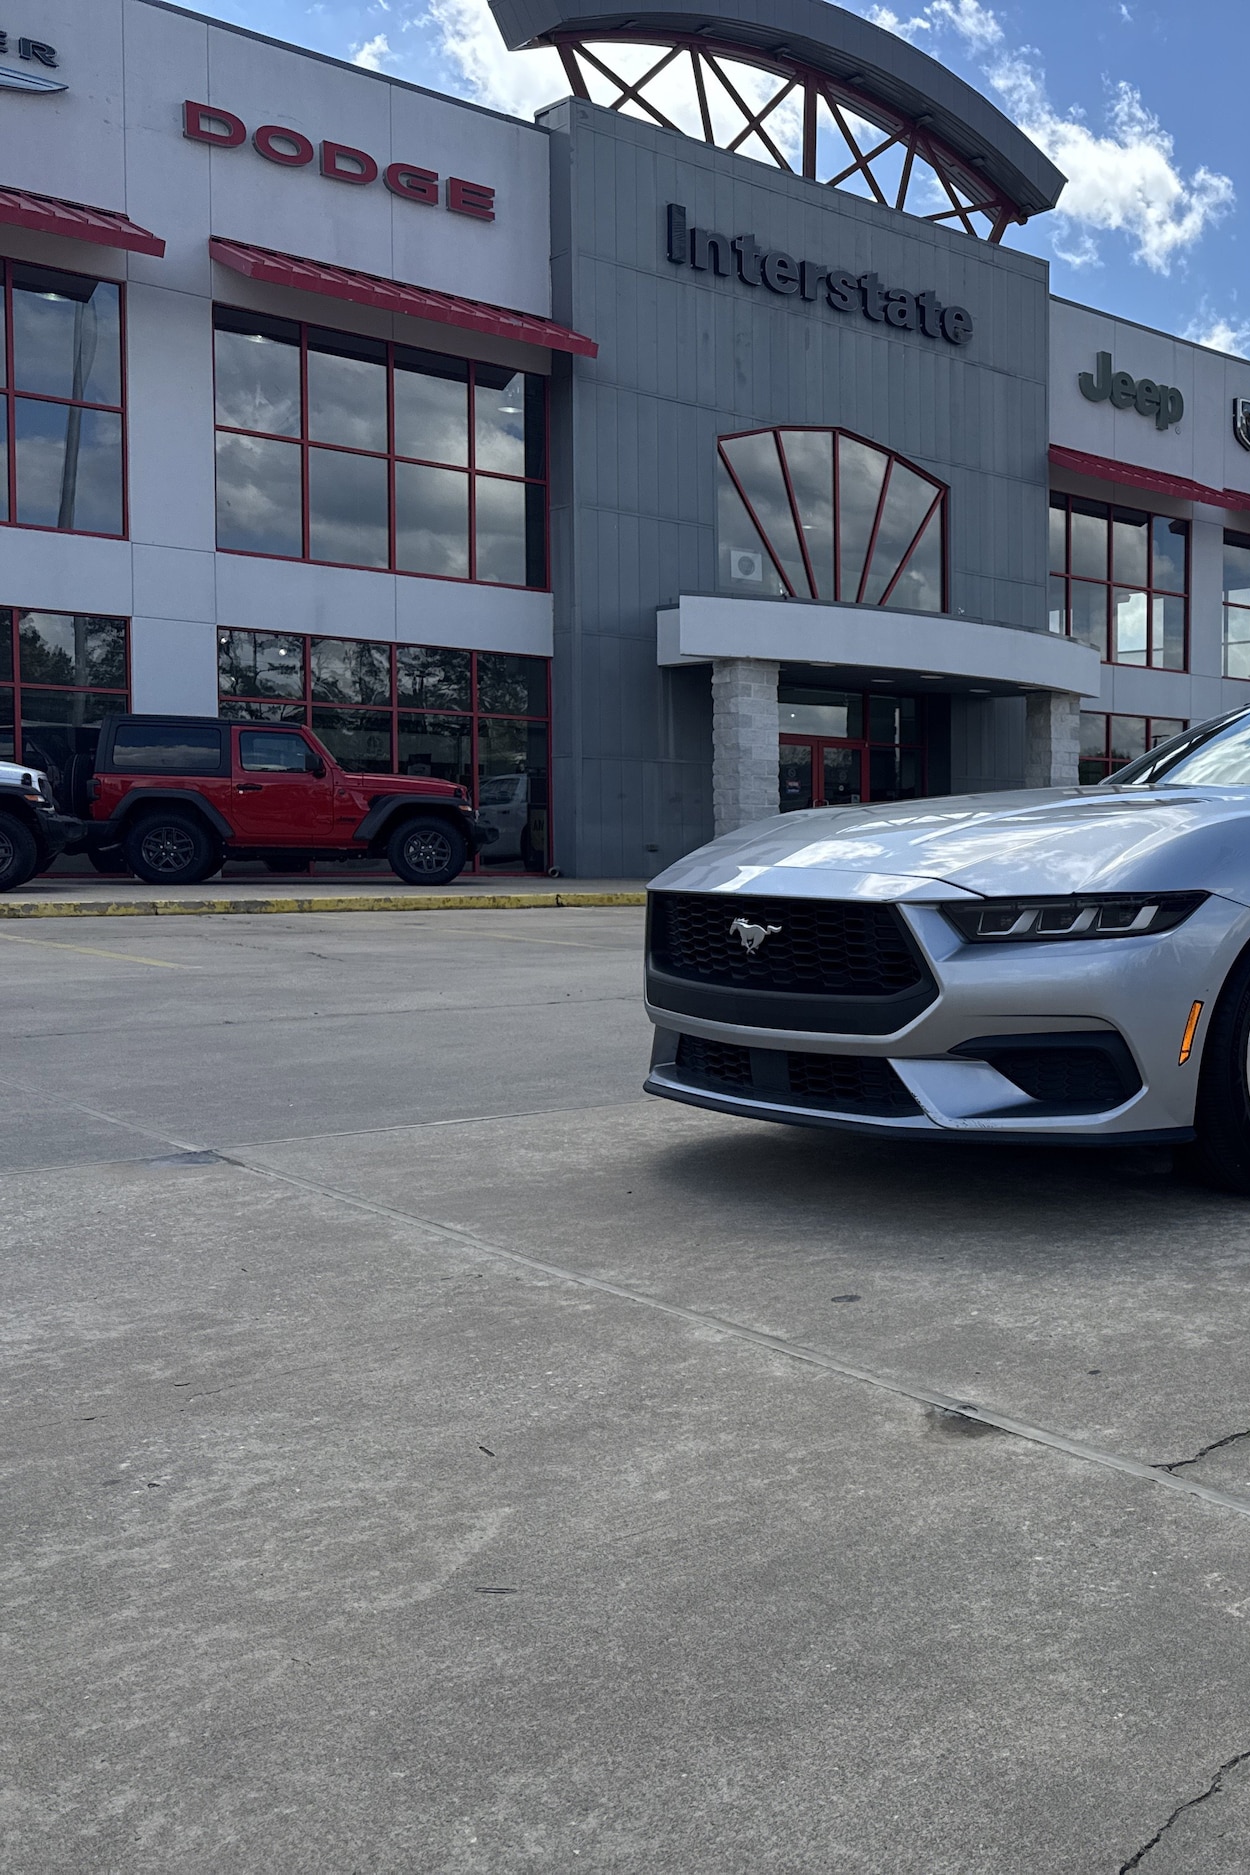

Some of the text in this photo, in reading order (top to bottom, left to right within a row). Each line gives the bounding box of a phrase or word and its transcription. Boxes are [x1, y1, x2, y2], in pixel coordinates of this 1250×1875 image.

[182, 99, 496, 222] DODGE
[667, 203, 974, 345] Interstate
[1078, 351, 1184, 431] Jeep
